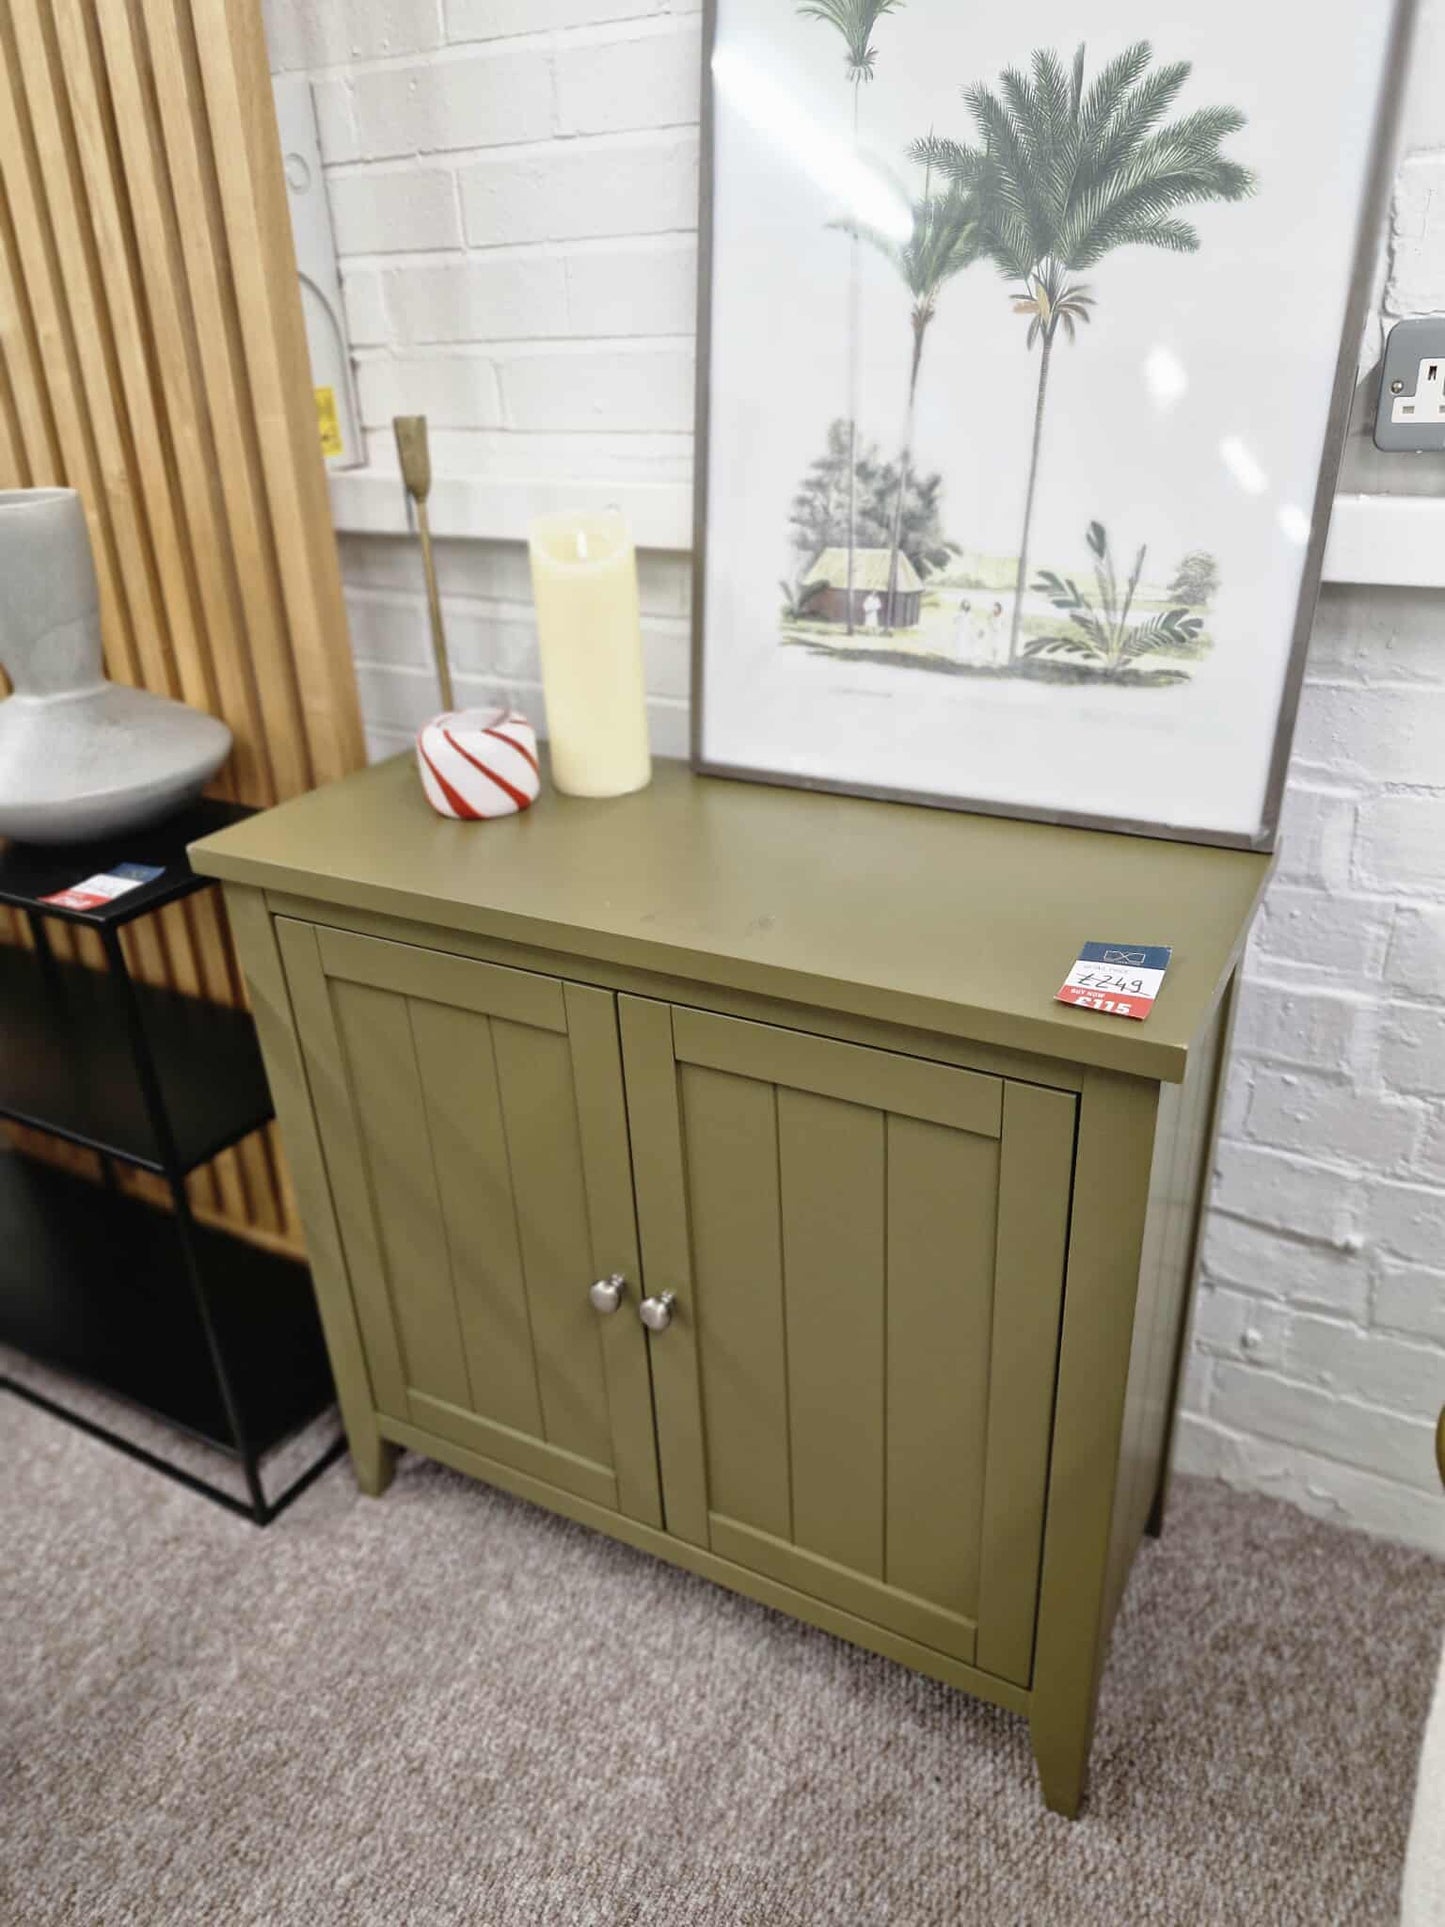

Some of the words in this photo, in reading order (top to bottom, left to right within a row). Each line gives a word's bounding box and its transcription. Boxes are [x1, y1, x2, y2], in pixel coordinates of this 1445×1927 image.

[1078, 973, 1143, 993] £249
[1087, 990, 1106, 998] NOW
[1075, 996, 1132, 1014] £115
